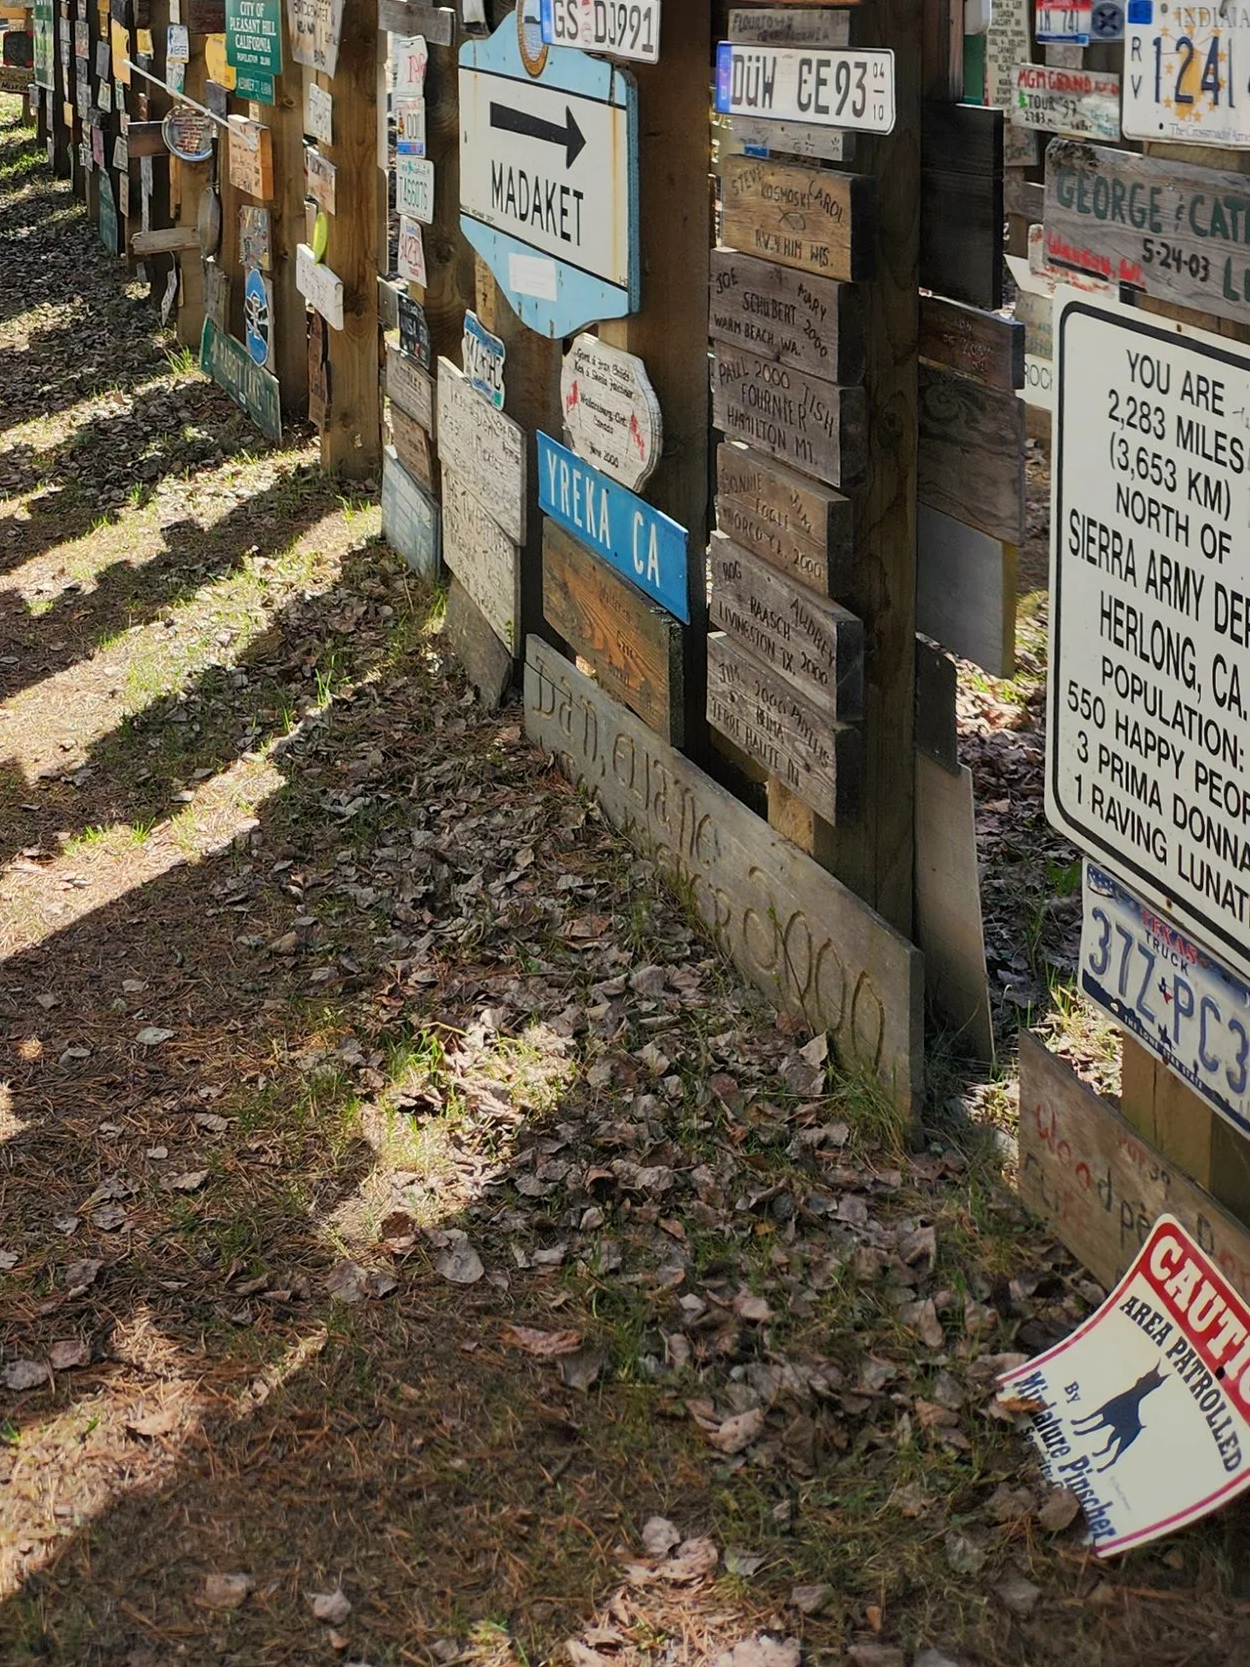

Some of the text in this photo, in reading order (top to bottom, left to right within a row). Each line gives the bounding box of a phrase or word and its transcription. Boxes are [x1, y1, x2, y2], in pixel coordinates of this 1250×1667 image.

[229, 17, 277, 36] PLEASANT HILL
[239, 1, 265, 17] CITY OF
[235, 34, 272, 53] CALIFORNIA
[872, 61, 885, 79] 04
[872, 103, 885, 121] 10
[1027, 93, 1056, 112] TOUR
[491, 159, 584, 247] MADAKET
[807, 180, 845, 226] CAROL
[1056, 168, 1163, 234] GEORGE
[1141, 237, 1211, 283] 5-24-03
[713, 313, 742, 336] WARM
[716, 267, 828, 322] JOE MARY
[742, 290, 797, 327] SCHUBERT
[717, 356, 835, 439] PAUL 2000 TISH
[741, 382, 807, 431] FOURNIER
[1126, 348, 1225, 418] YOU ARE
[726, 404, 787, 449] HAMILTON
[1107, 388, 1244, 476] 2,283 MILES
[1109, 430, 1231, 523] (3,653 KM)
[547, 448, 662, 589] YREKA CA
[1115, 481, 1232, 566] NORTH OF
[1068, 507, 1203, 622] SIERRA ARMY
[718, 601, 829, 686] LIVINGSTON 2000
[722, 561, 836, 667] ROG AUDREY
[749, 594, 792, 640] RAASCH
[1098, 590, 1249, 722] HERLONG, CA.
[710, 697, 781, 769] TERRE HAUTE
[790, 703, 832, 768] PHYLLIS
[1066, 679, 1184, 781] 550 HAPPY
[1101, 655, 1245, 774] POPULATION:
[1076, 729, 1162, 818] 3 PRIMA
[1074, 773, 1168, 864] 1 RAVING
[1140, 907, 1198, 966] TEXAS
[1145, 934, 1189, 975] TRUCK
[1063, 1380, 1083, 1406] By
[1119, 1295, 1243, 1474] AREA PATROLLED
[1058, 1454, 1118, 1539] Pinscher
